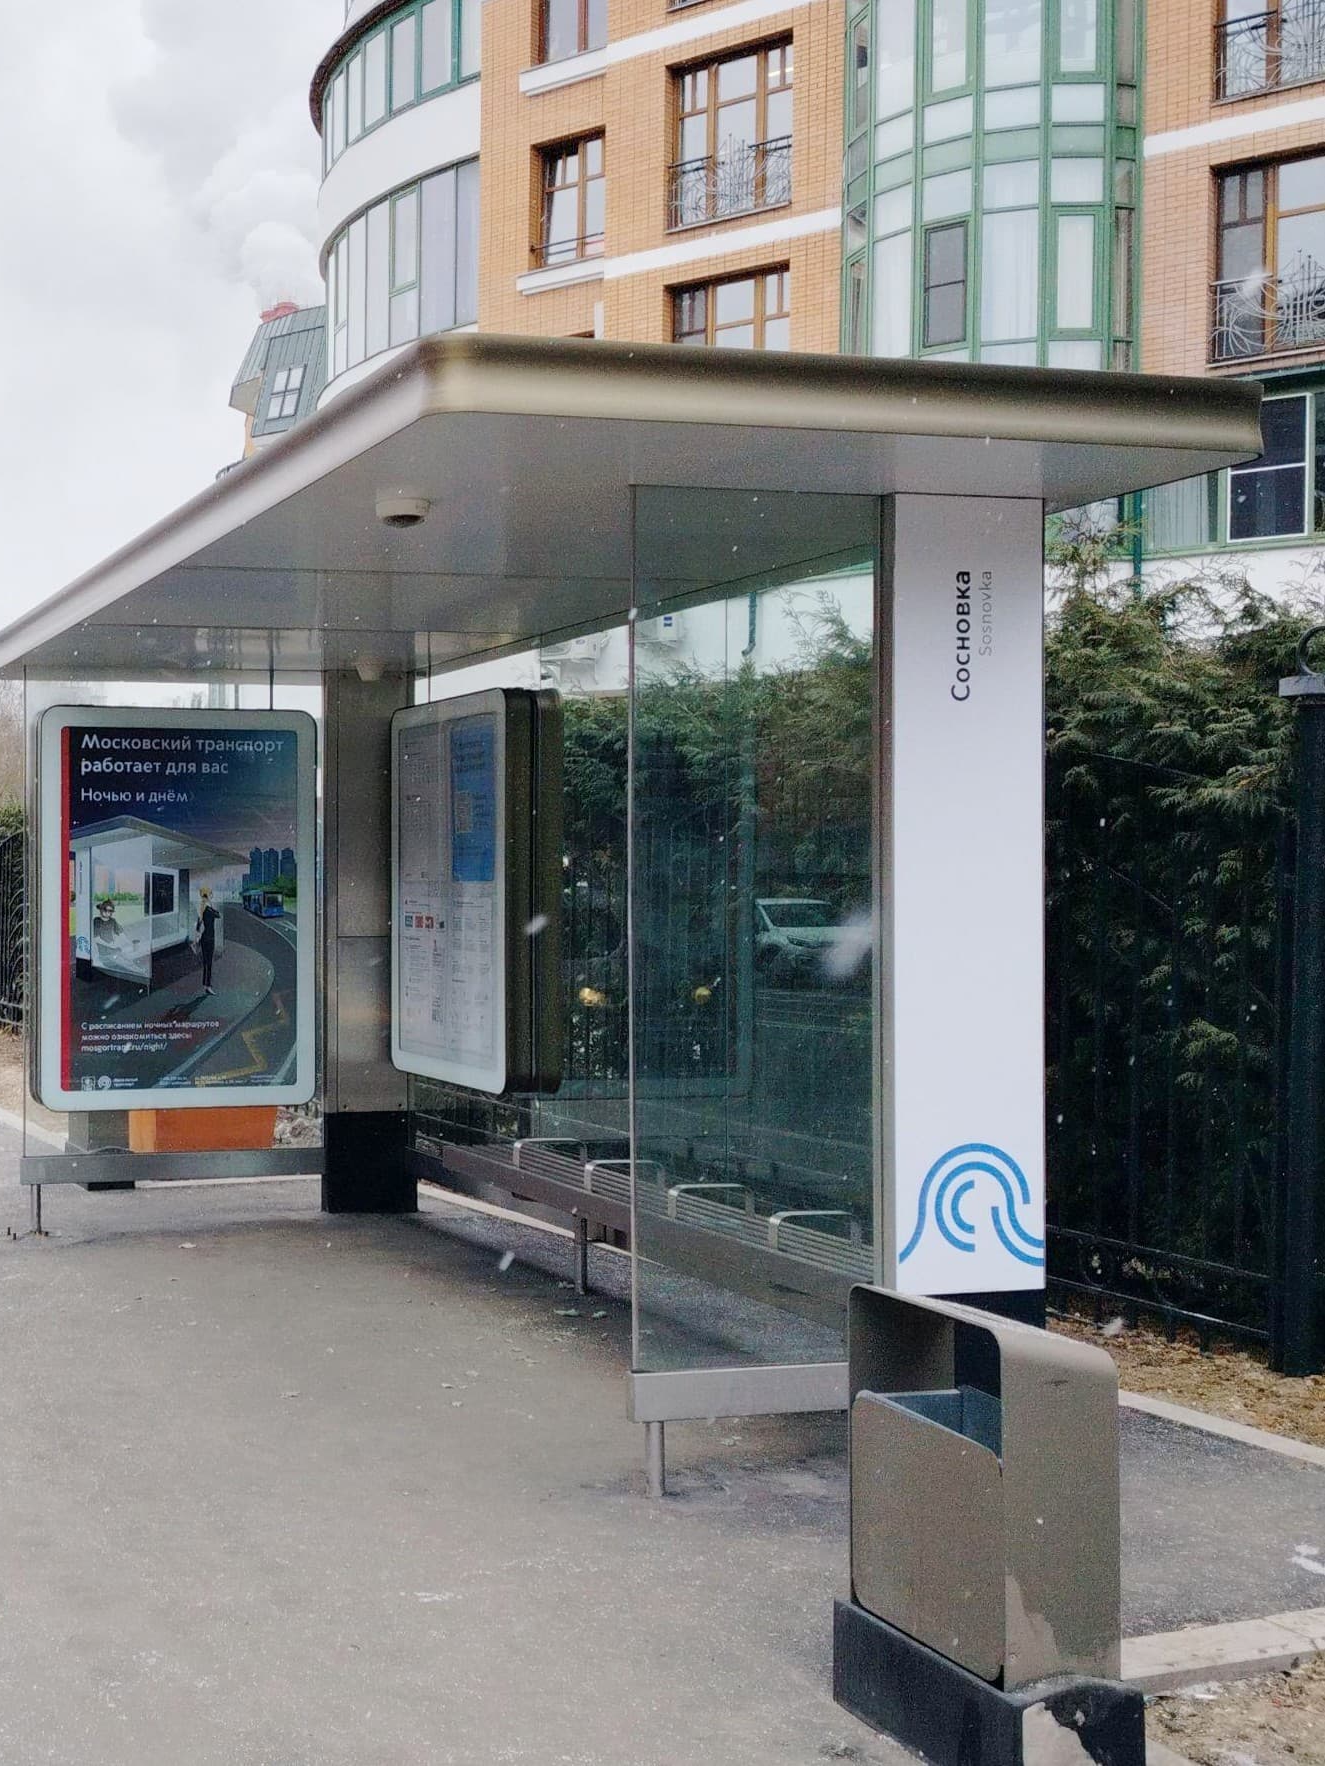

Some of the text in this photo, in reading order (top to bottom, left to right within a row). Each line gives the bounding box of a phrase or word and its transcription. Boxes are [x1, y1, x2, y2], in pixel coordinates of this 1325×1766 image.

[978, 571, 993, 657] Sosnovka
[951, 571, 971, 701] Сосновка
[81, 734, 284, 755] Московский транспорт
[81, 757, 229, 776] работает для вас
[80, 788, 189, 804] Ночью и днём
[81, 1021, 220, 1032] С расписанием ночных маршрутов
[81, 1034, 110, 1042] можно
[111, 1033, 167, 1041] ознакомиться
